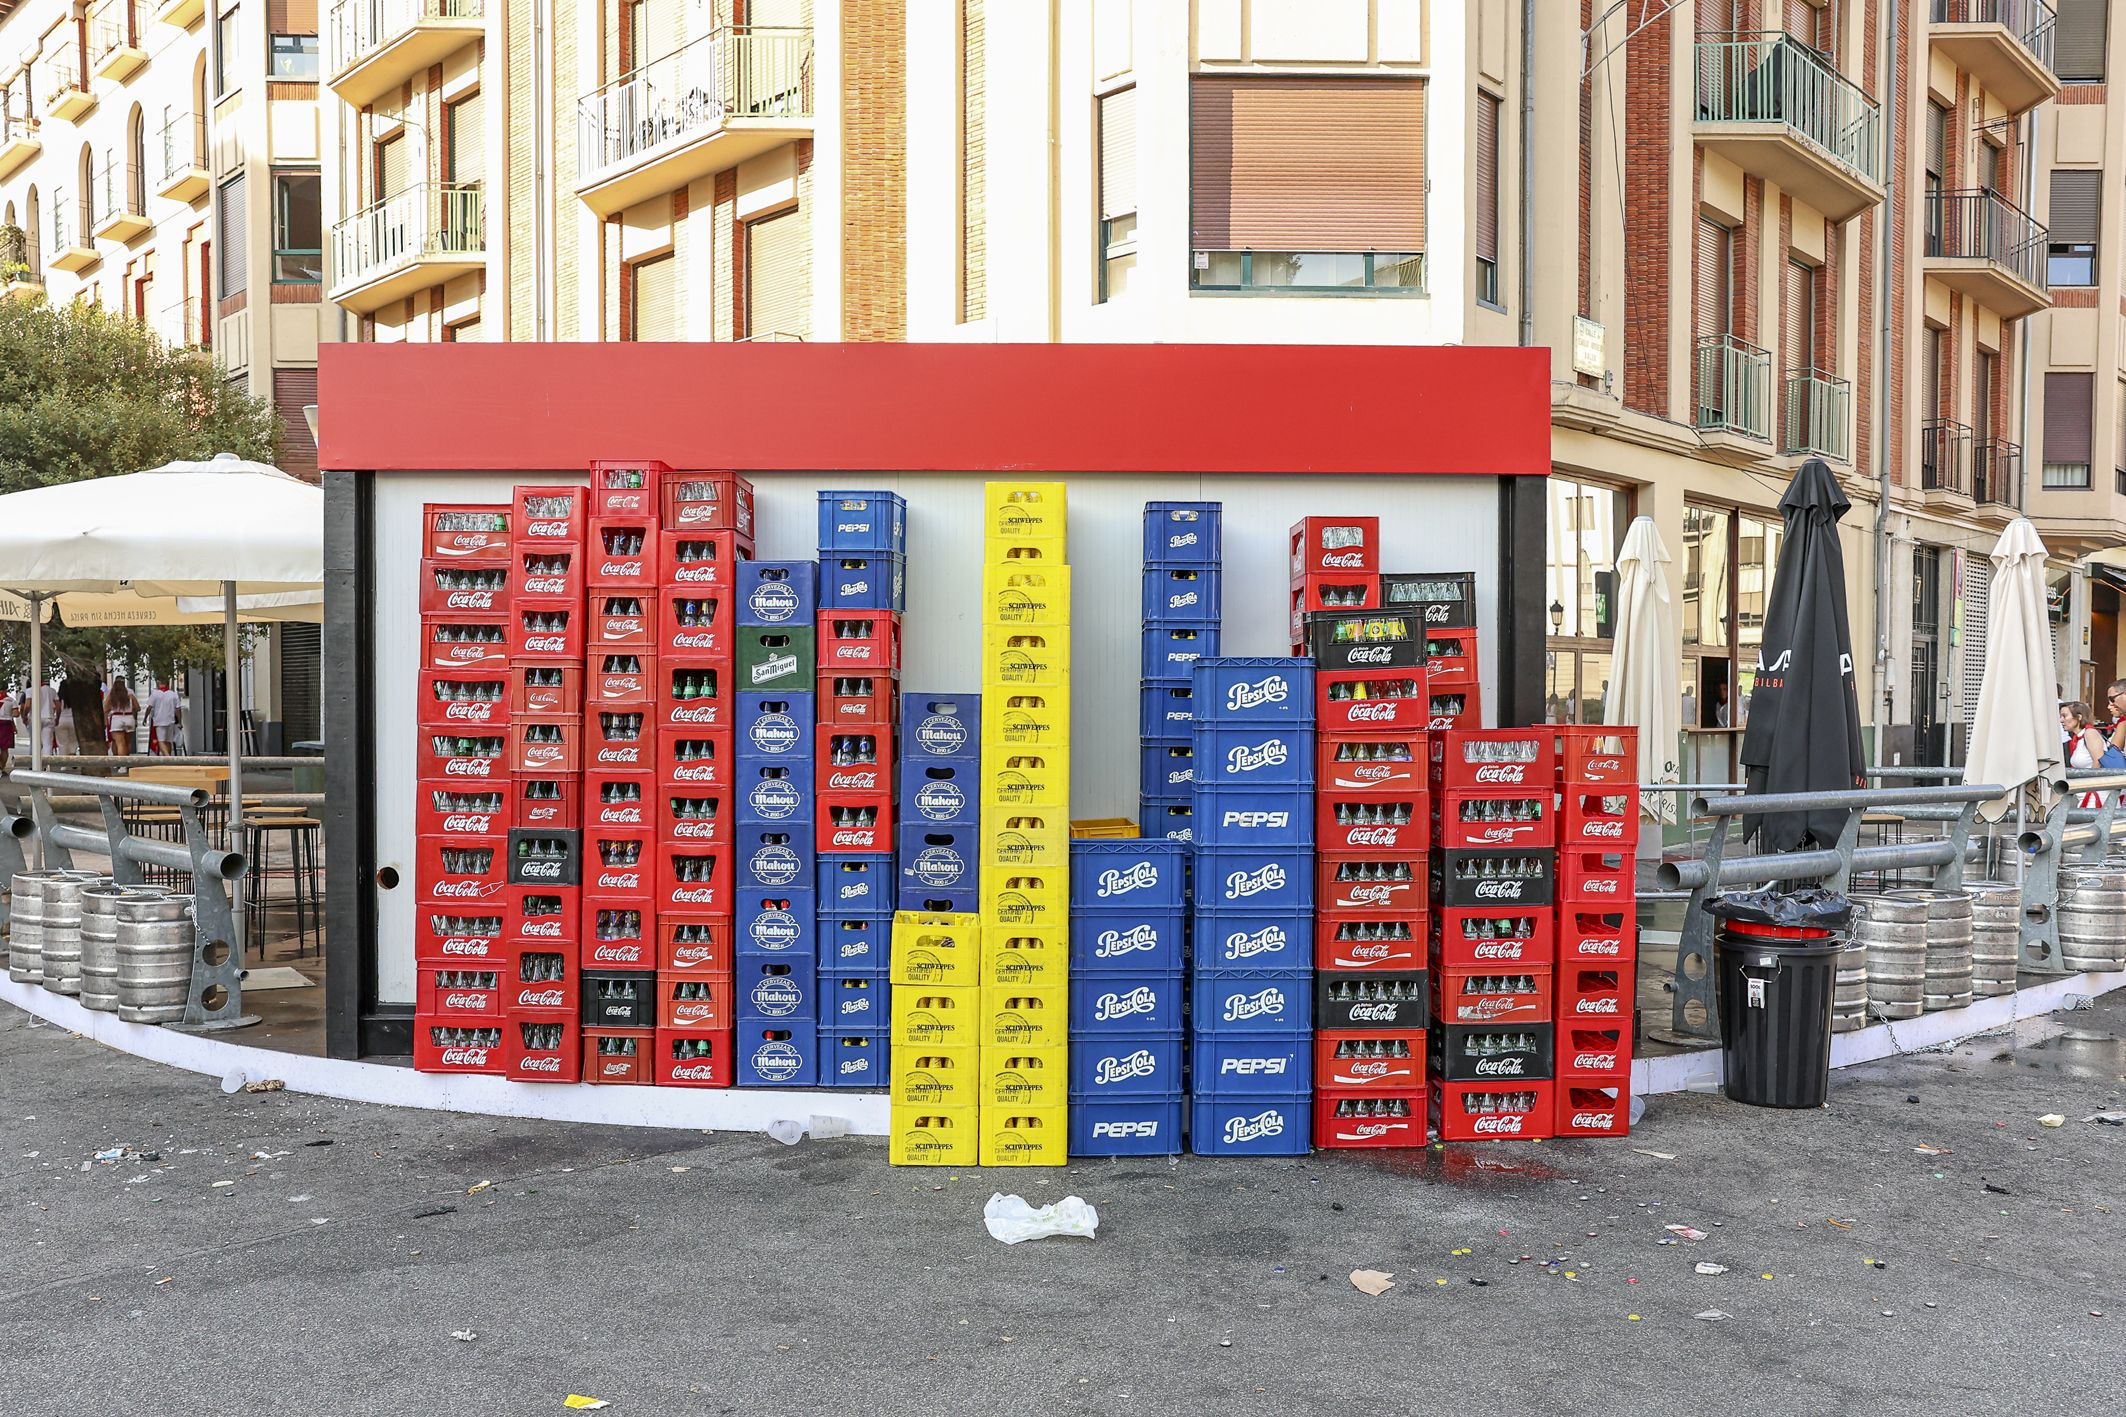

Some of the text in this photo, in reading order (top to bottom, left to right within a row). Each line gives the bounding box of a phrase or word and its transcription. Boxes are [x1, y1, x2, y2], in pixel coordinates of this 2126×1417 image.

[838, 524, 869, 532] PEPSI
[754, 597, 793, 608] Mahou
[1167, 712, 1192, 720] PEPS
[755, 728, 794, 739] Mahou
[922, 729, 961, 740] Mahou
[754, 794, 795, 805] Mahou
[920, 795, 961, 806] Mahou
[1223, 812, 1289, 828] PEPSI
[755, 860, 795, 871] Mahou
[919, 862, 959, 873] Mahou
[755, 925, 795, 937] Mahou
[756, 991, 797, 1002] Mahou
[757, 1056, 797, 1067] Mahou
[1221, 1058, 1287, 1074] PEPSI
[1093, 1122, 1158, 1138] PEPSI
